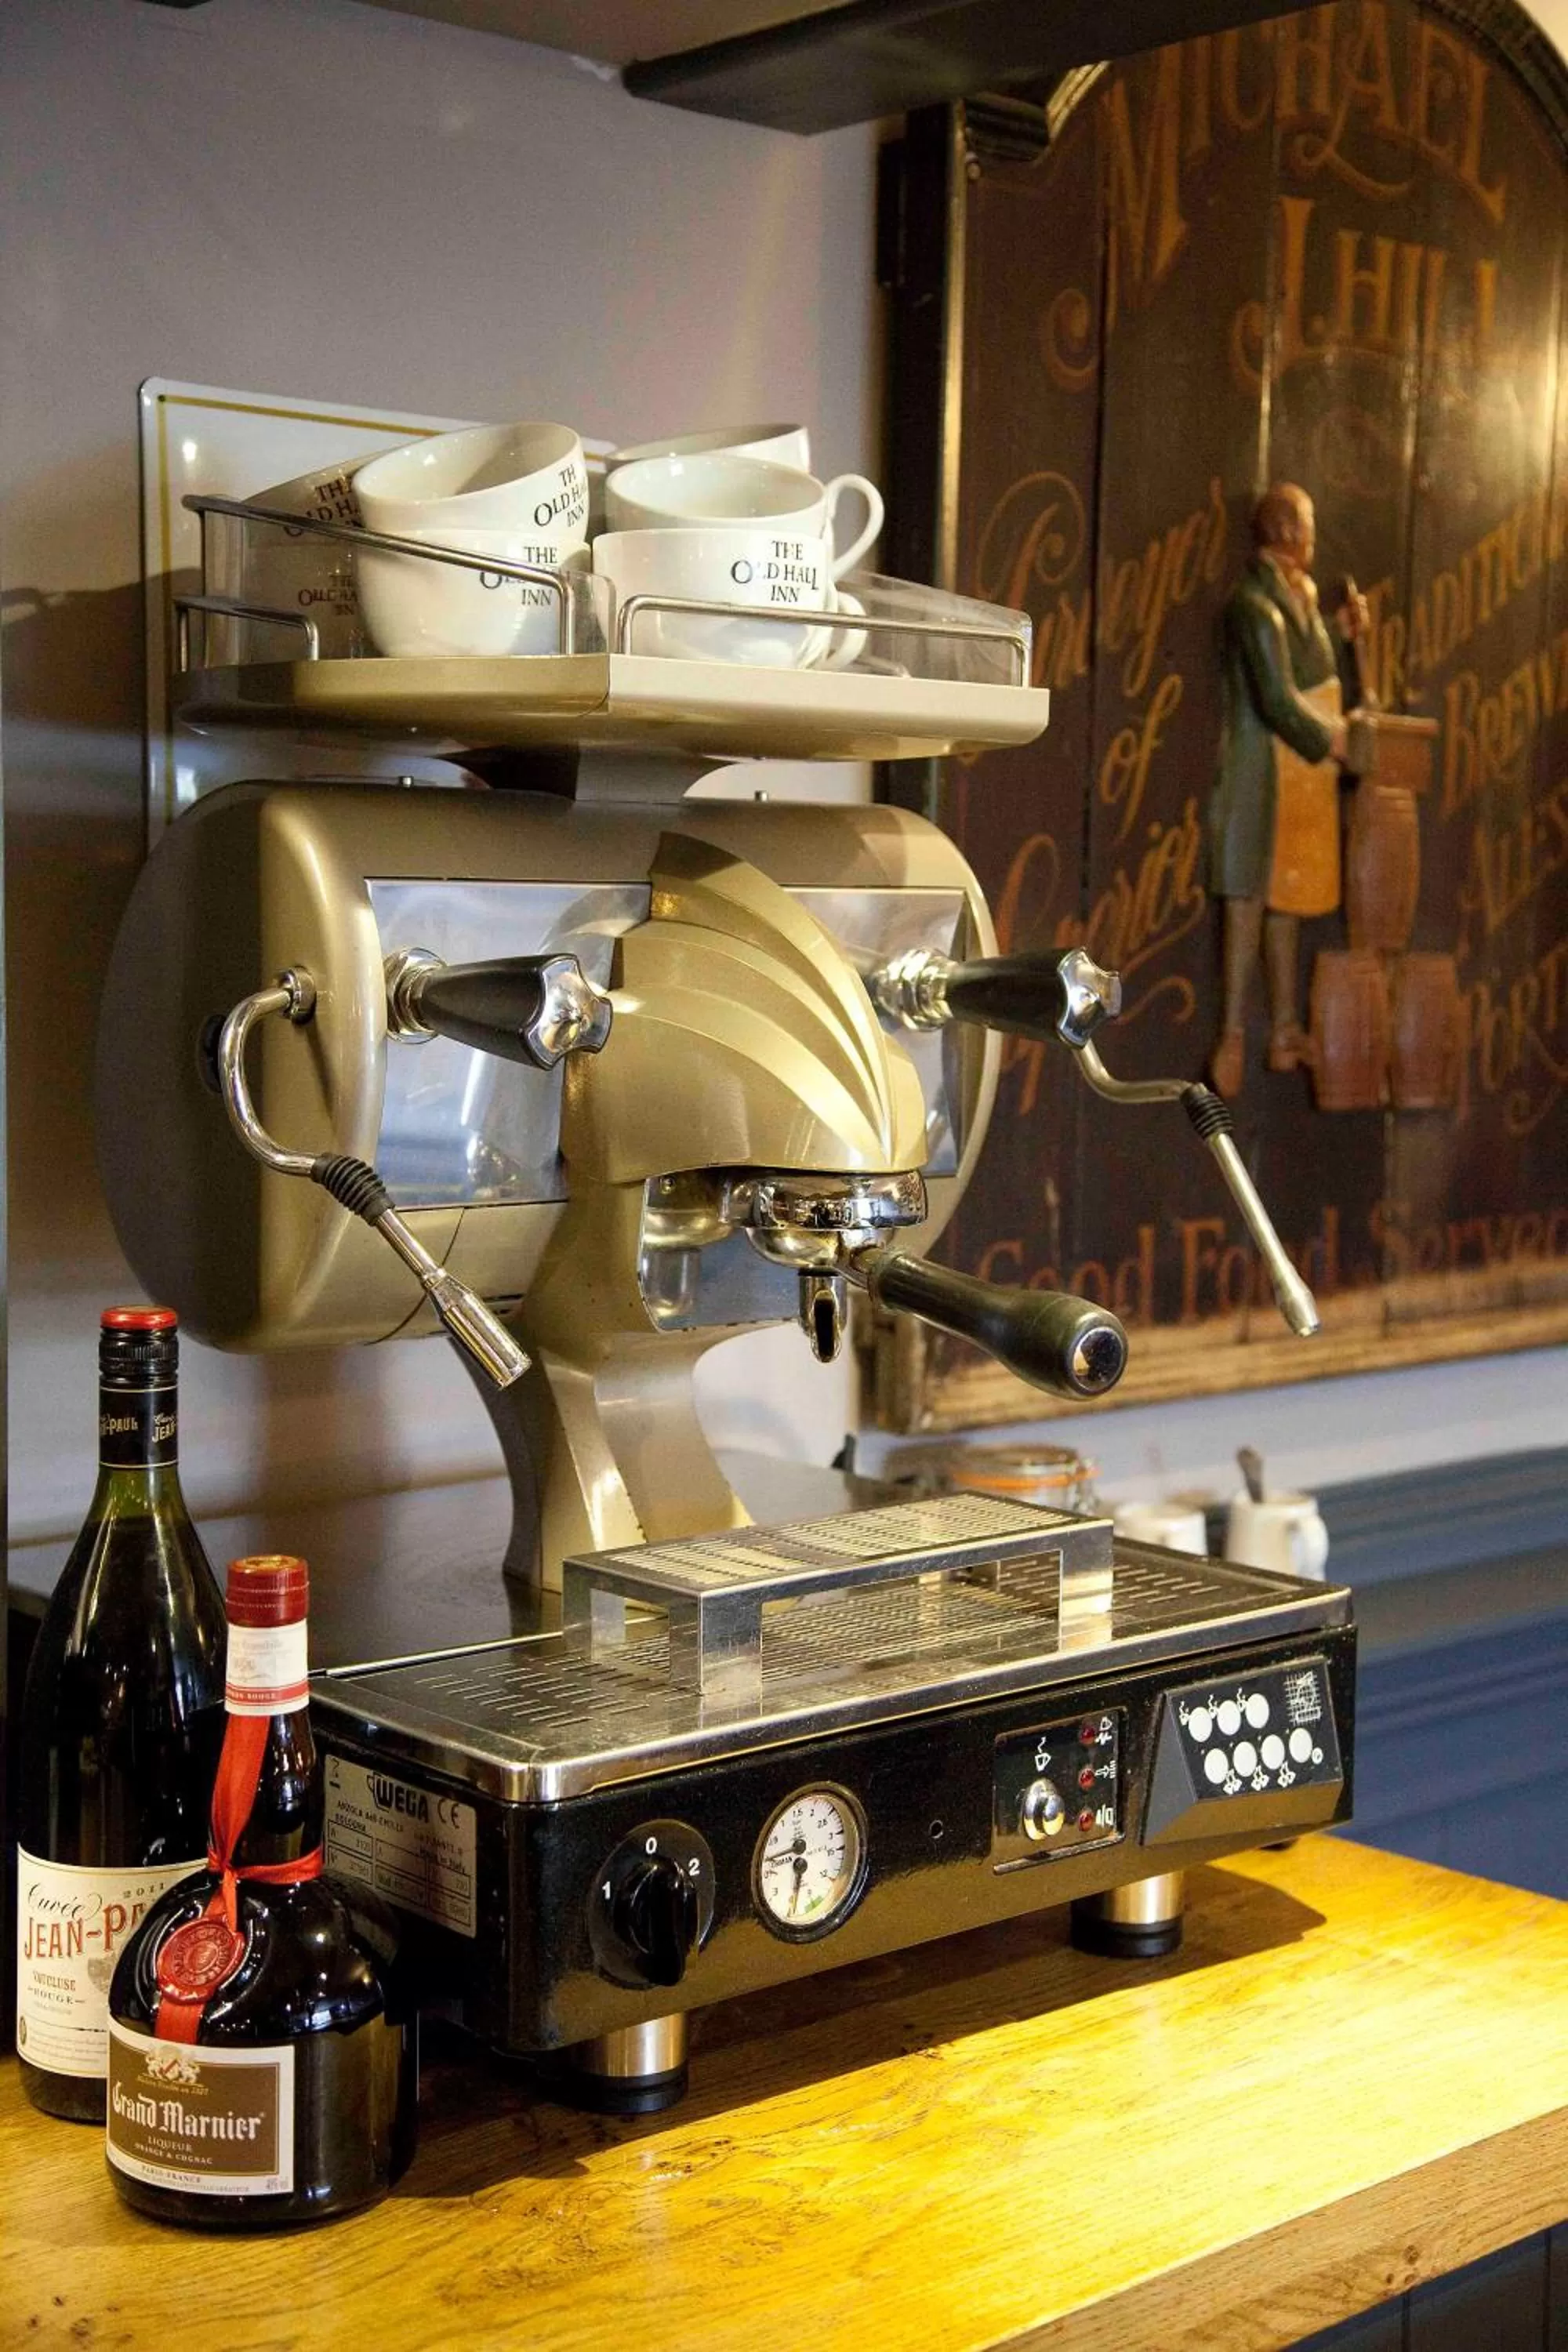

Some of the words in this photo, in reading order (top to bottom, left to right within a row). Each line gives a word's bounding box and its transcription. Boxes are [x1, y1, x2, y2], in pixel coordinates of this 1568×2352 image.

[559, 464, 576, 486] TH
[535, 493, 570, 527] OLD
[524, 546, 557, 564] THE
[771, 540, 804, 561] THE
[731, 560, 780, 584] OD
[784, 564, 819, 590] HALL
[521, 589, 552, 606] INN
[771, 585, 800, 603] INN
[1102, 674, 1182, 840] of
[376, 1777, 430, 1824] WEGA
[645, 1837, 658, 1855] 0
[689, 1857, 700, 1876] 2
[123, 1882, 165, 1900] 2011
[602, 1881, 611, 1900] 1
[28, 1882, 103, 1921] Cuvée
[24, 1902, 147, 1960] JEAN-PA
[113, 2082, 158, 2129] Grand
[159, 2098, 262, 2140] Marnier
[148, 2135, 194, 2154] LIQUEUR
[175, 2154, 213, 2165] COGNAC
